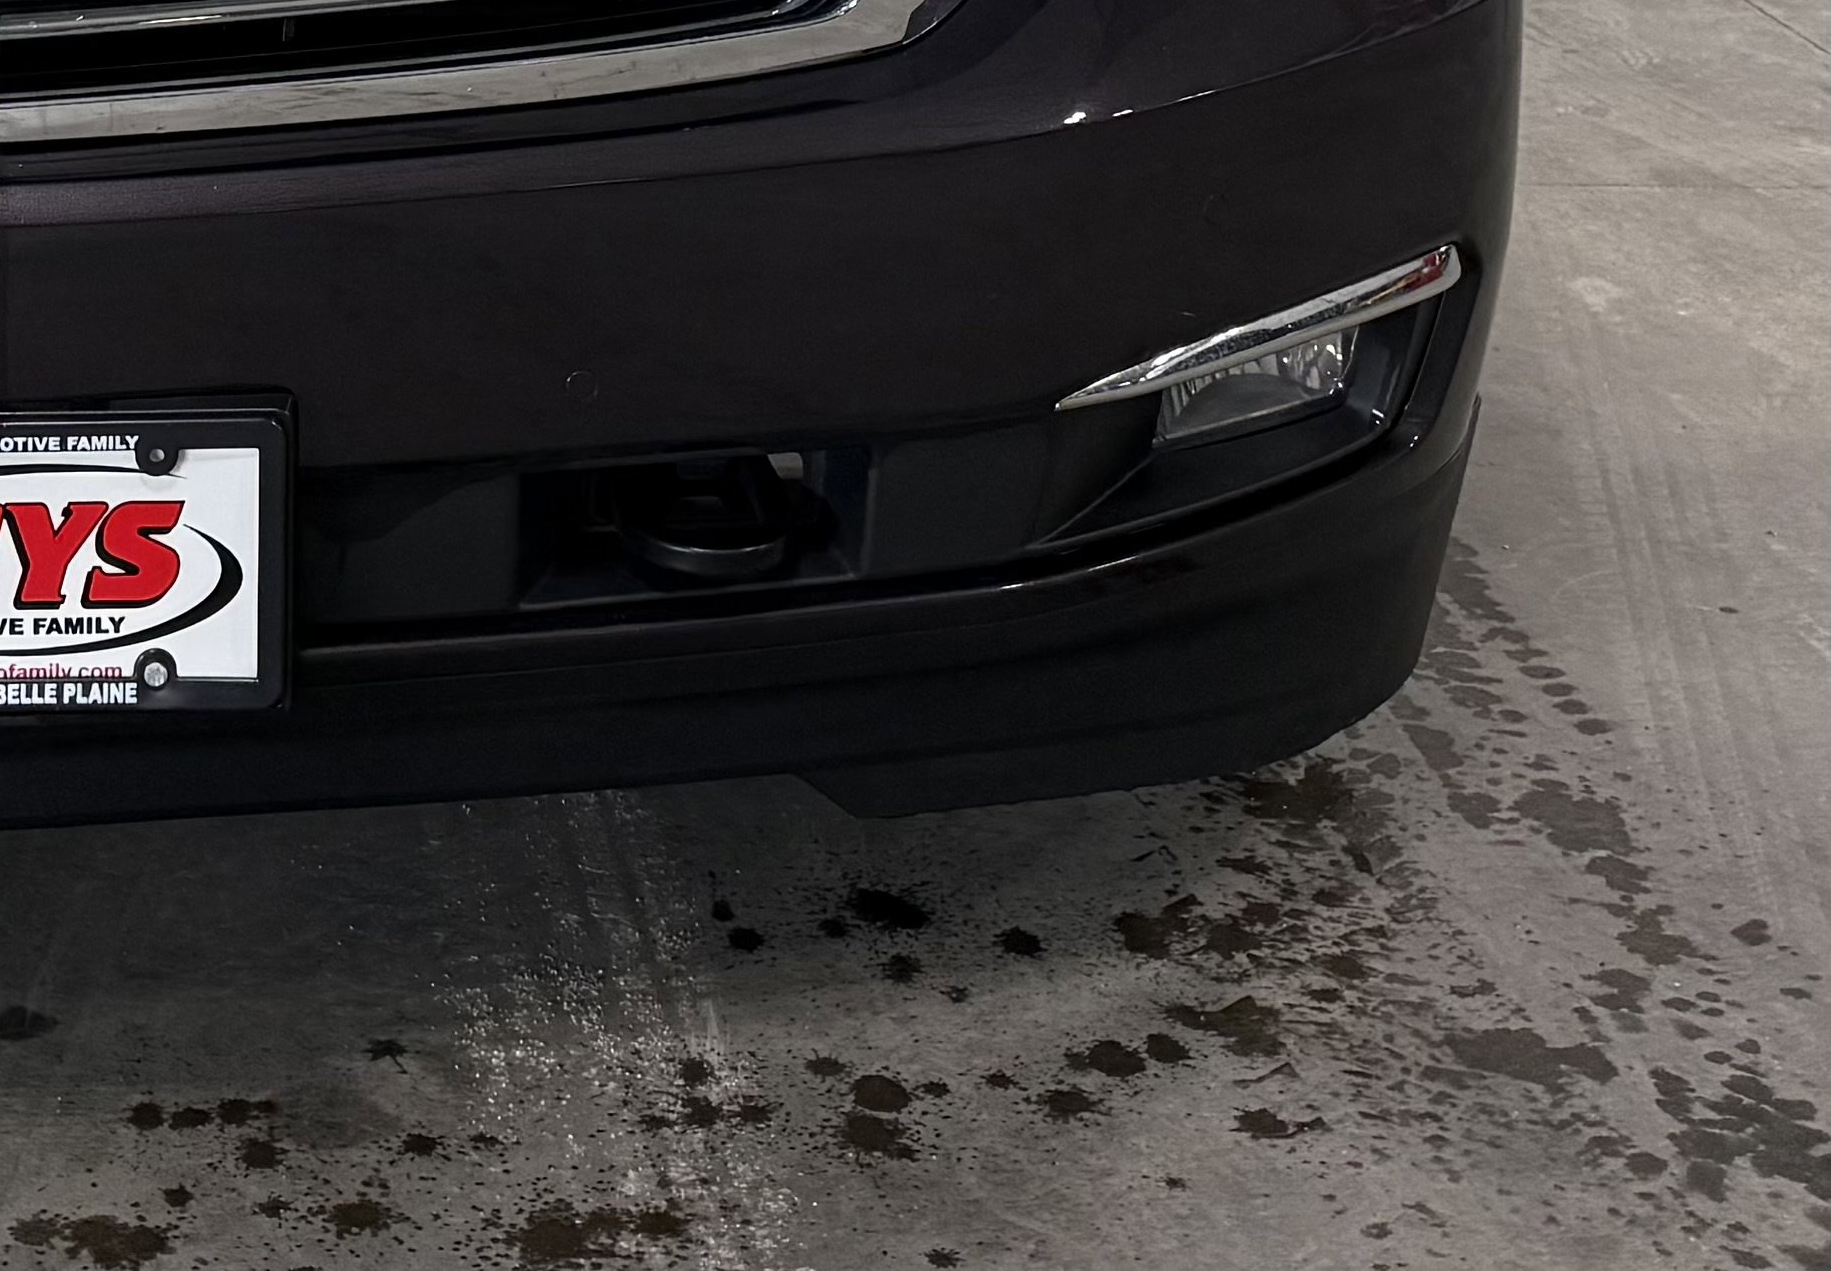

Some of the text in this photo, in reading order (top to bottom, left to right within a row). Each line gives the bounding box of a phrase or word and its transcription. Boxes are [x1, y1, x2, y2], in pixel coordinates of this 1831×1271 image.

[66, 435, 139, 451] FAMILY
[32, 615, 126, 636] FAMILY
[63, 682, 138, 705] PLAINE
